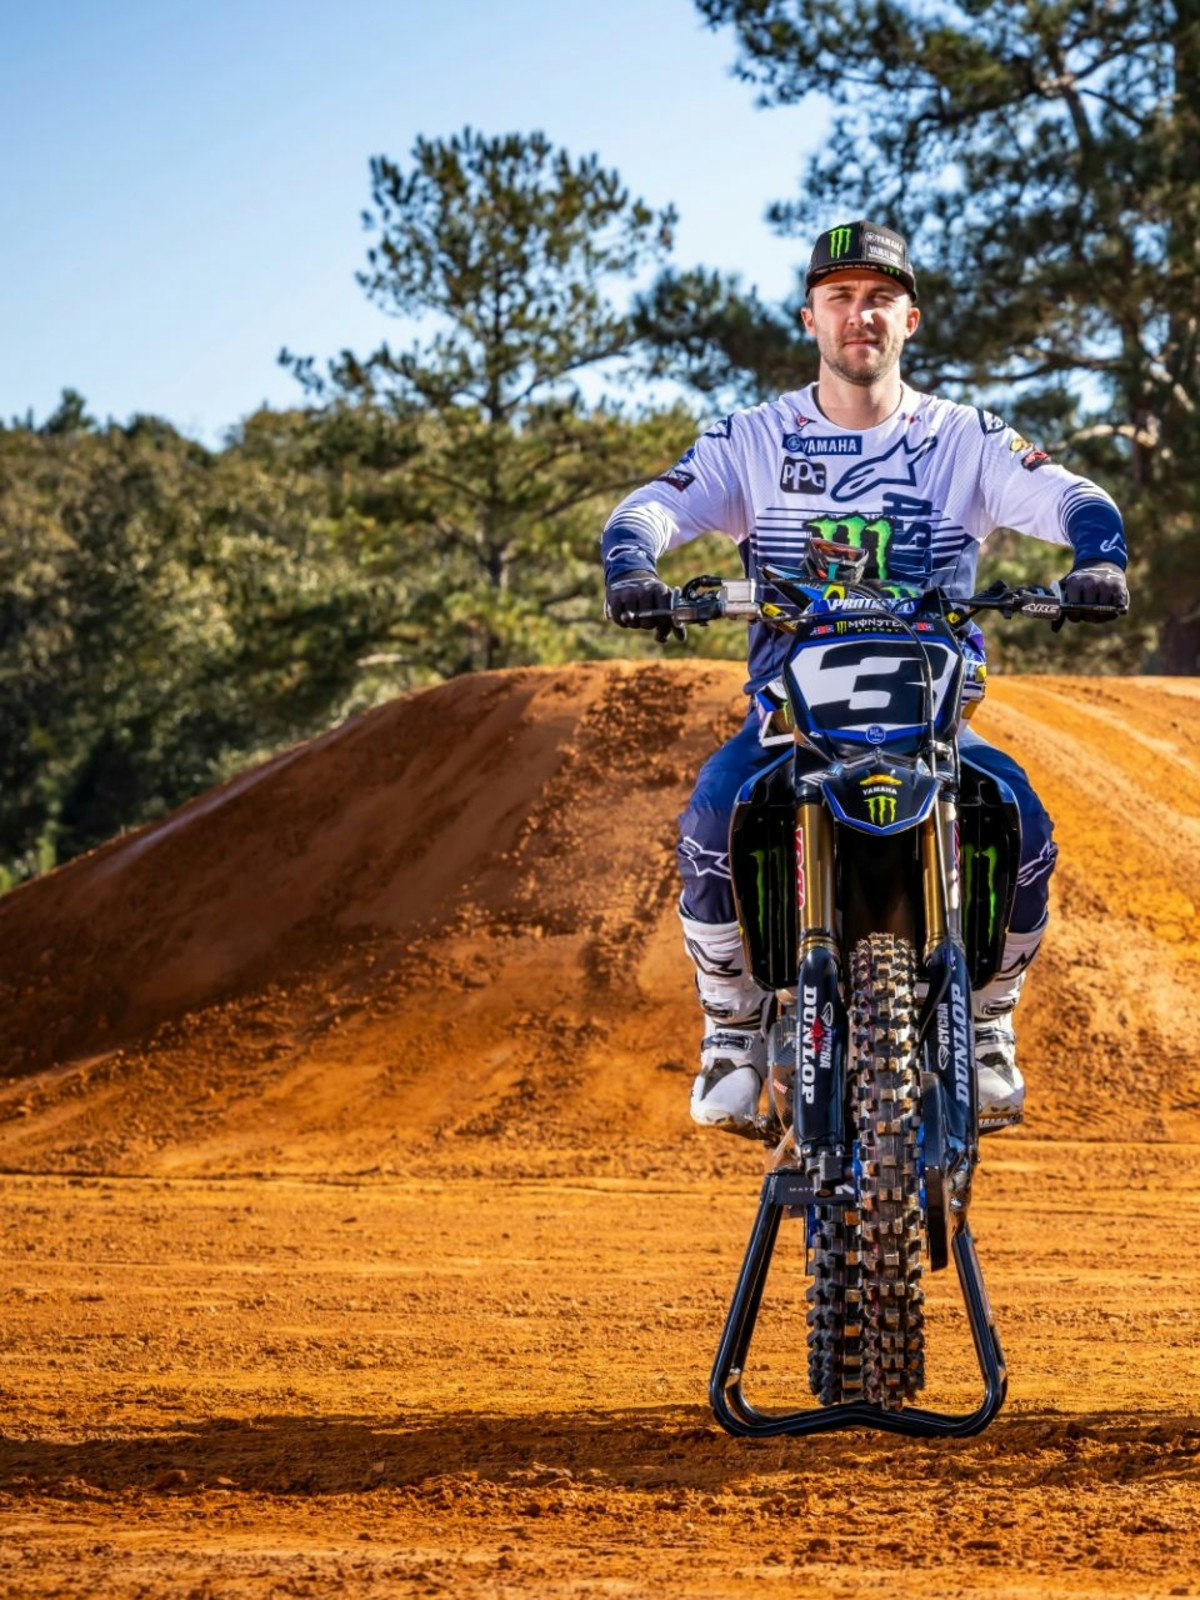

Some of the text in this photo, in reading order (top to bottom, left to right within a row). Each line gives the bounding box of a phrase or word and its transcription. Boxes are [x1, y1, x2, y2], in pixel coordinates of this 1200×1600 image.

[803, 438, 858, 454] YAMAHA
[782, 460, 825, 491] PPG
[848, 617, 904, 629] MONSTE
[809, 640, 949, 729] 3
[862, 787, 898, 796] YAMAHA
[937, 1002, 950, 1047] CYCRA
[801, 984, 818, 1105] DUNLOP
[950, 982, 971, 1107] DUNLOP
